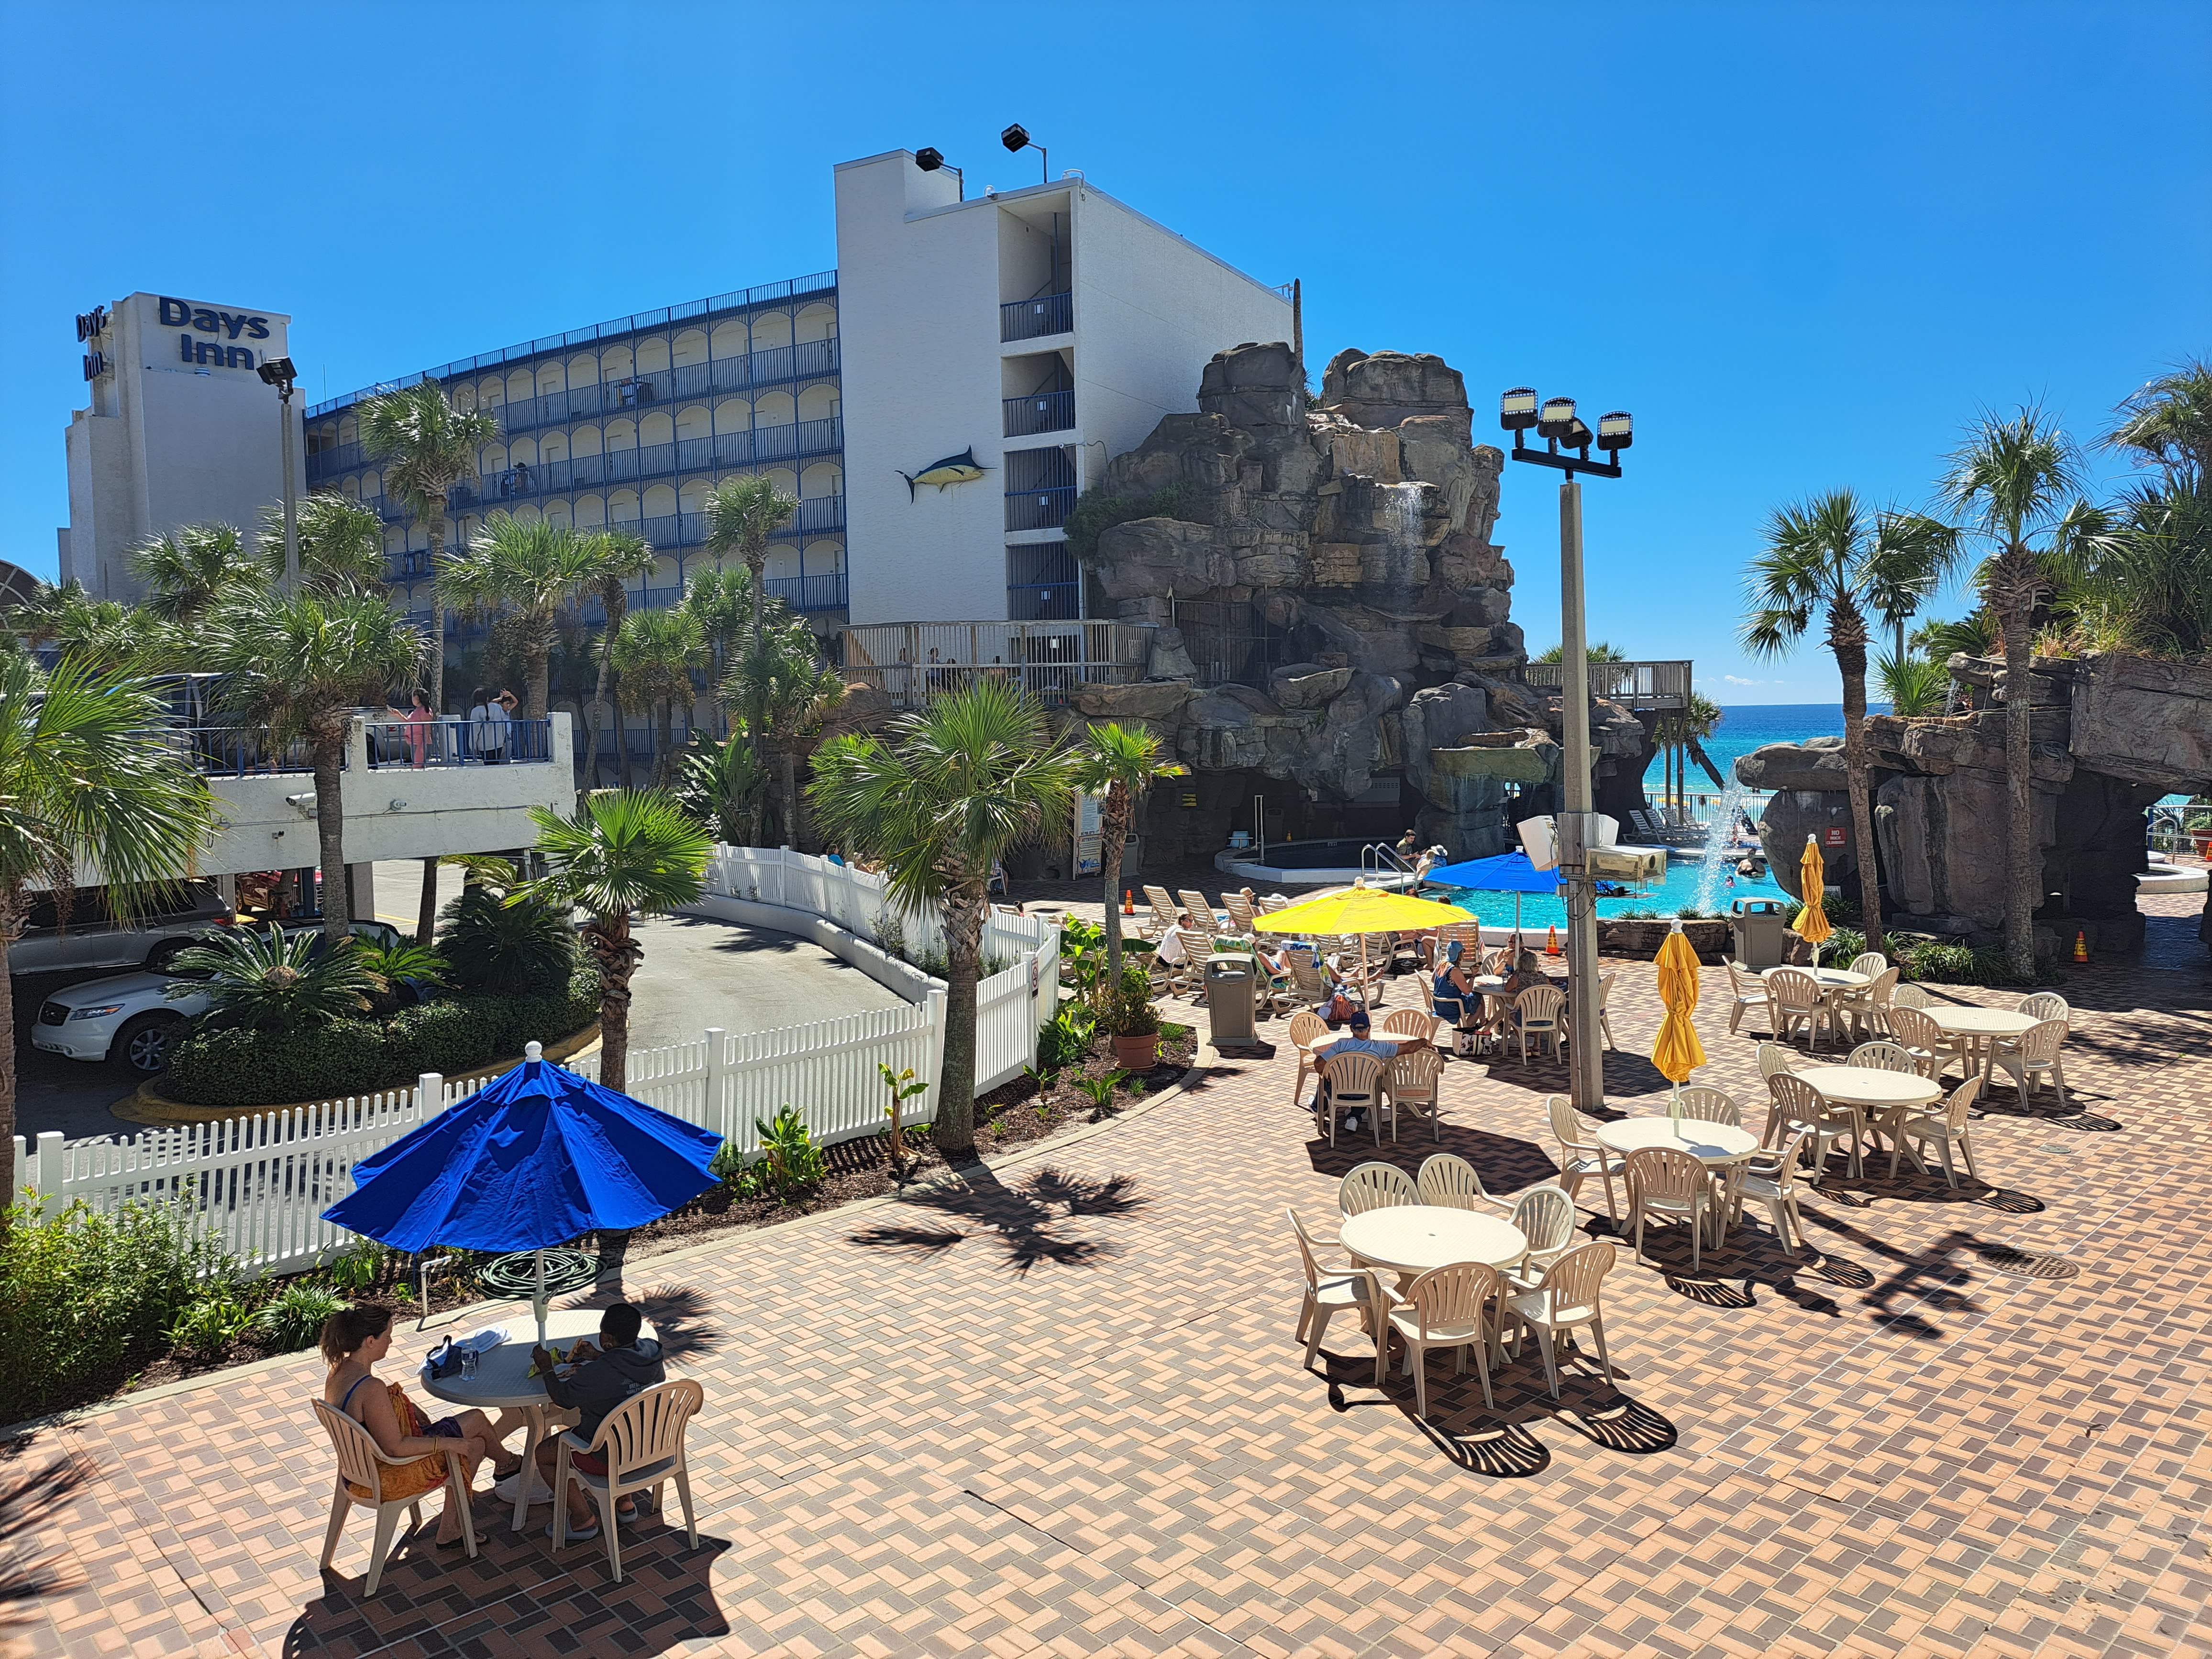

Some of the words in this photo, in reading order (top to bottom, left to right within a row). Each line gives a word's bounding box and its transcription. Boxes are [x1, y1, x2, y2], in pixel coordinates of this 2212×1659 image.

[76, 305, 107, 343] Days
[159, 296, 270, 340] Days
[83, 351, 103, 382] Inn
[181, 334, 254, 370] Inn
